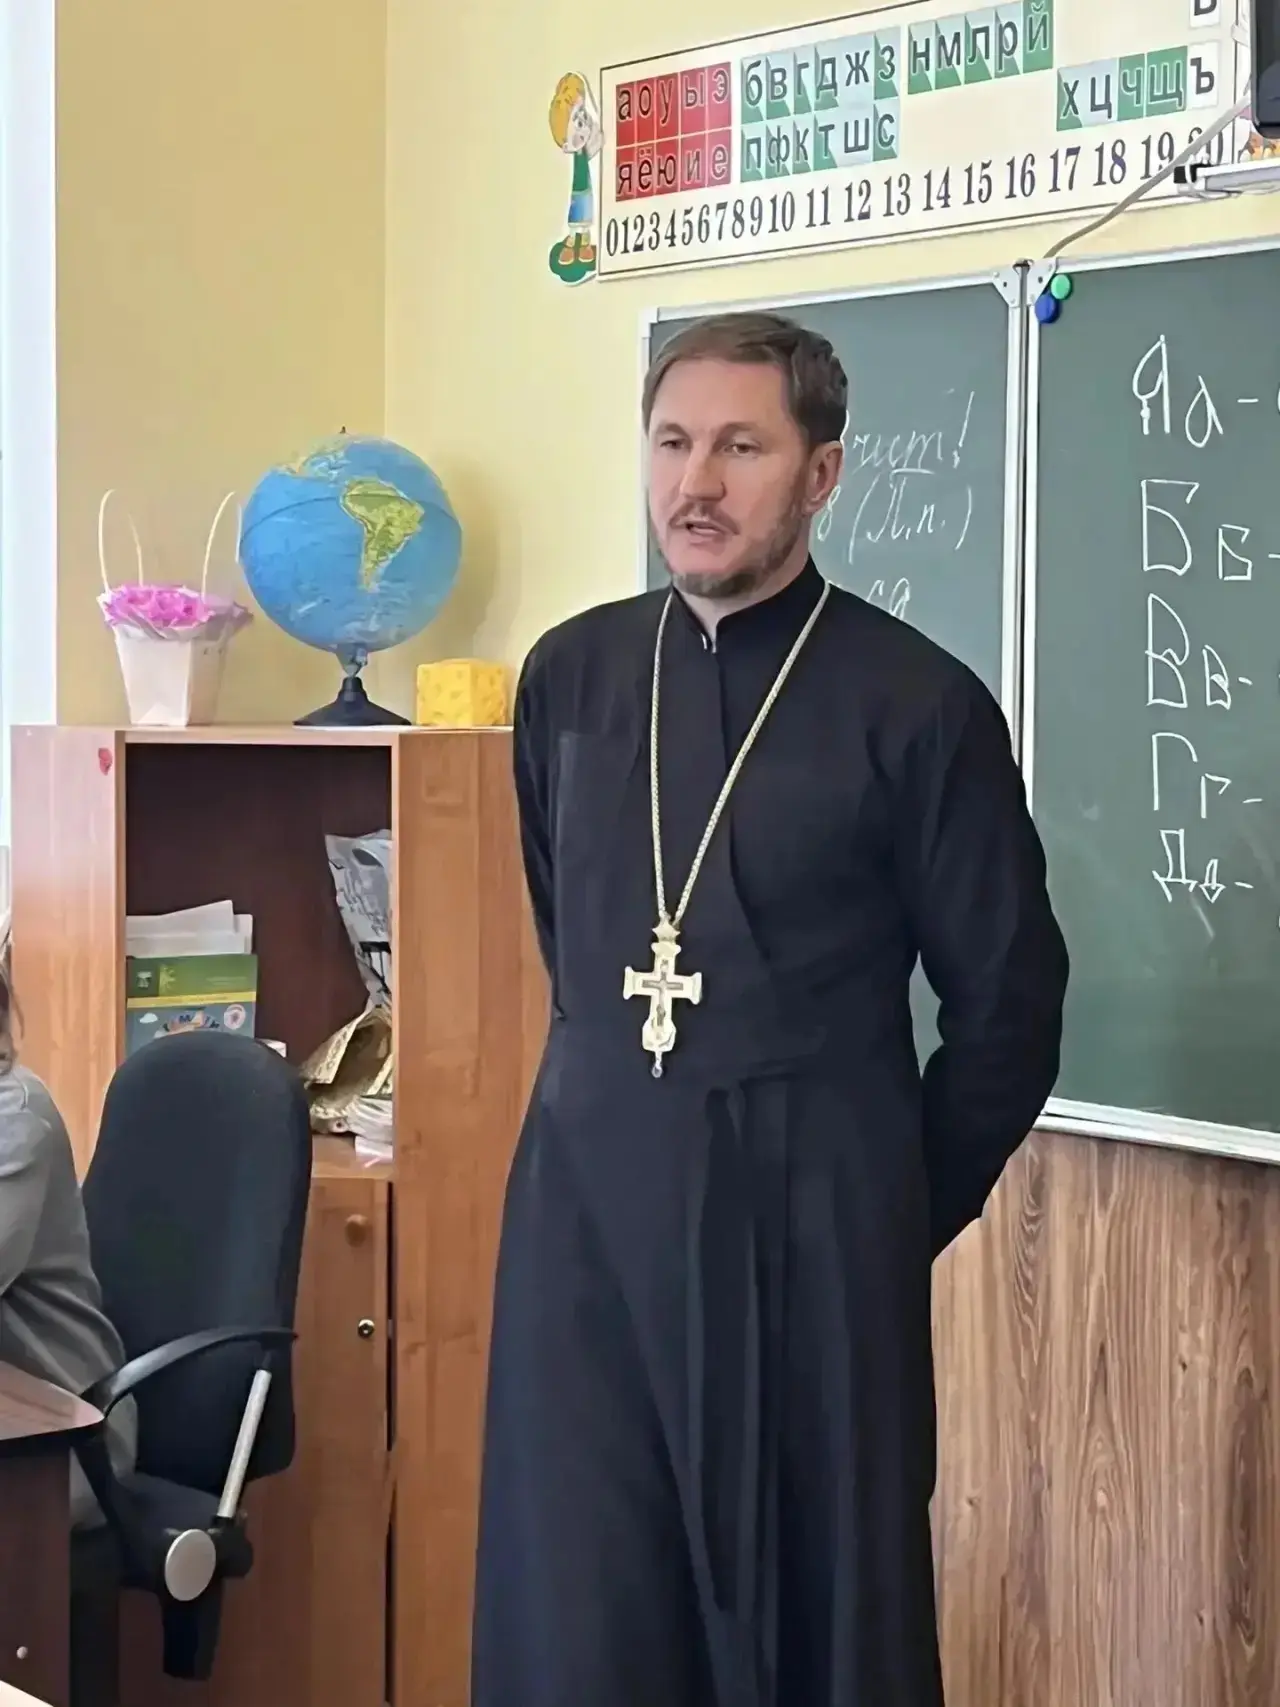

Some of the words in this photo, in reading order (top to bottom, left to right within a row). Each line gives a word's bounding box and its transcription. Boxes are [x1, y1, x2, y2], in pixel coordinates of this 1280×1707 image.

[806, 184, 830, 228] 11
[844, 179, 871, 222] 12
[883, 173, 911, 216] 13
[922, 166, 951, 211] 14
[963, 160, 992, 205] 15
[1005, 153, 1035, 199] 16
[1048, 146, 1081, 193] 17
[1093, 139, 1126, 187] 18
